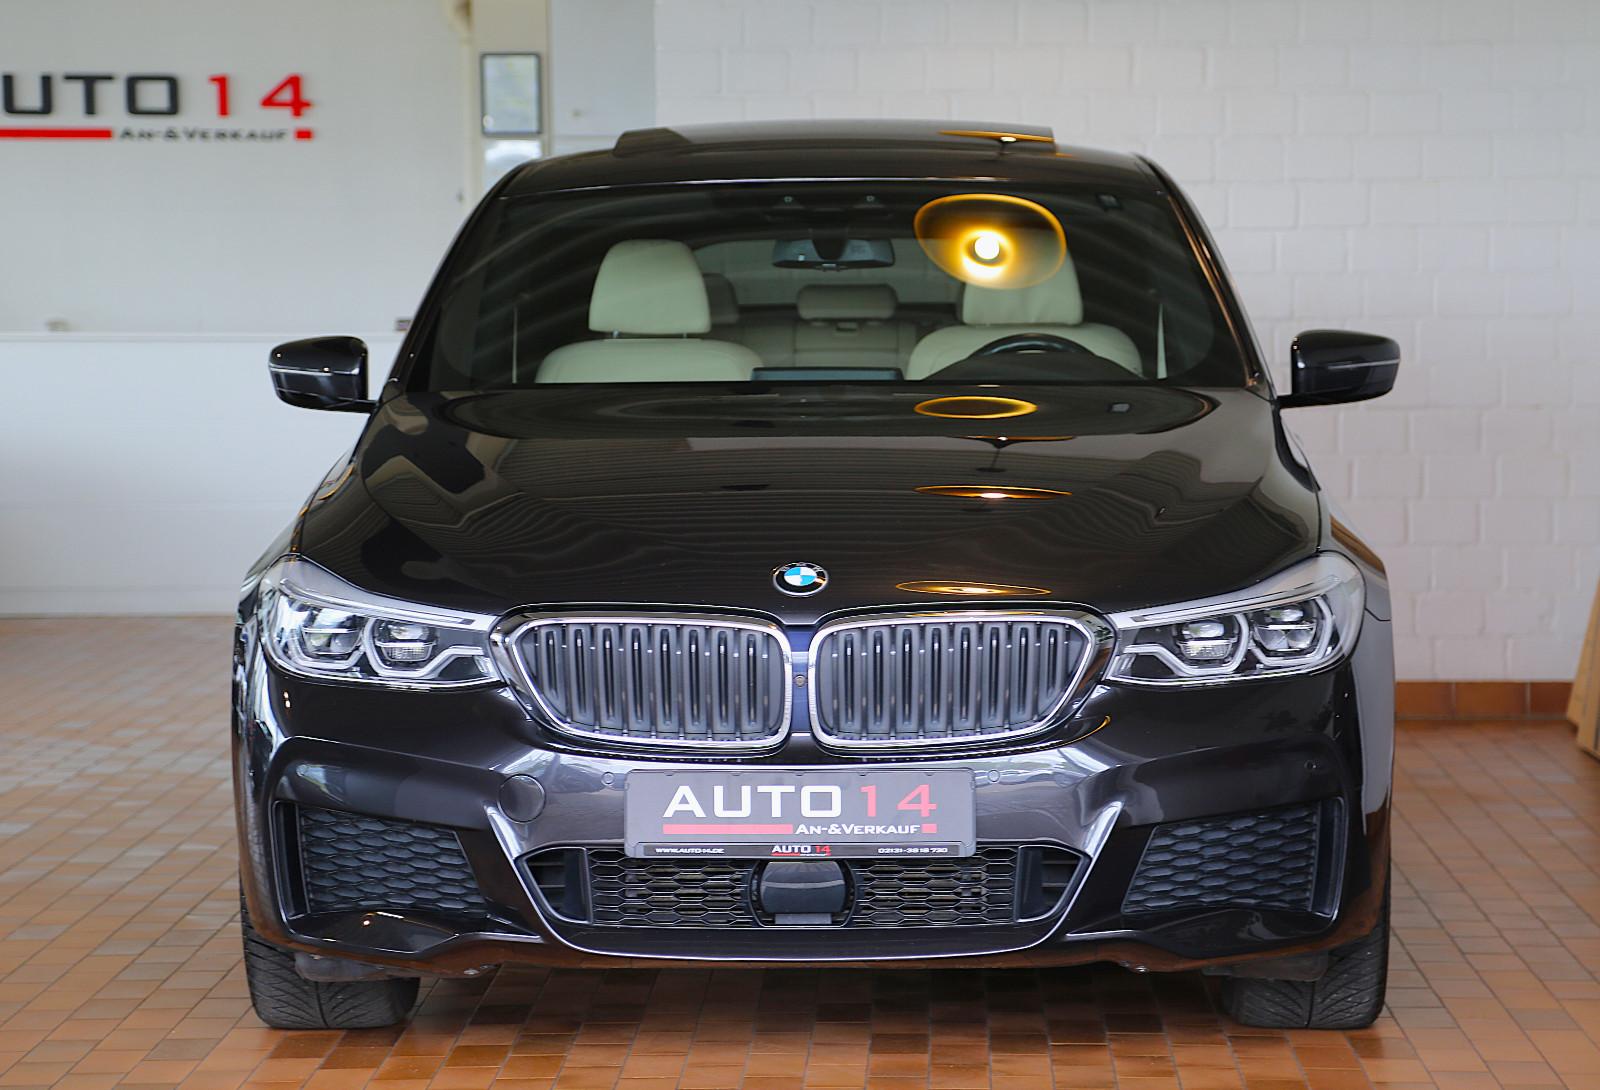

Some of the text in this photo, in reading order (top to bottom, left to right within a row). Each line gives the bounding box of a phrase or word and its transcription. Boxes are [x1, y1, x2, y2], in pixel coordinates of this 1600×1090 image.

[209, 74, 312, 117] 14
[662, 784, 938, 818] AUTO 14
[772, 845, 831, 854] AUTO 14
